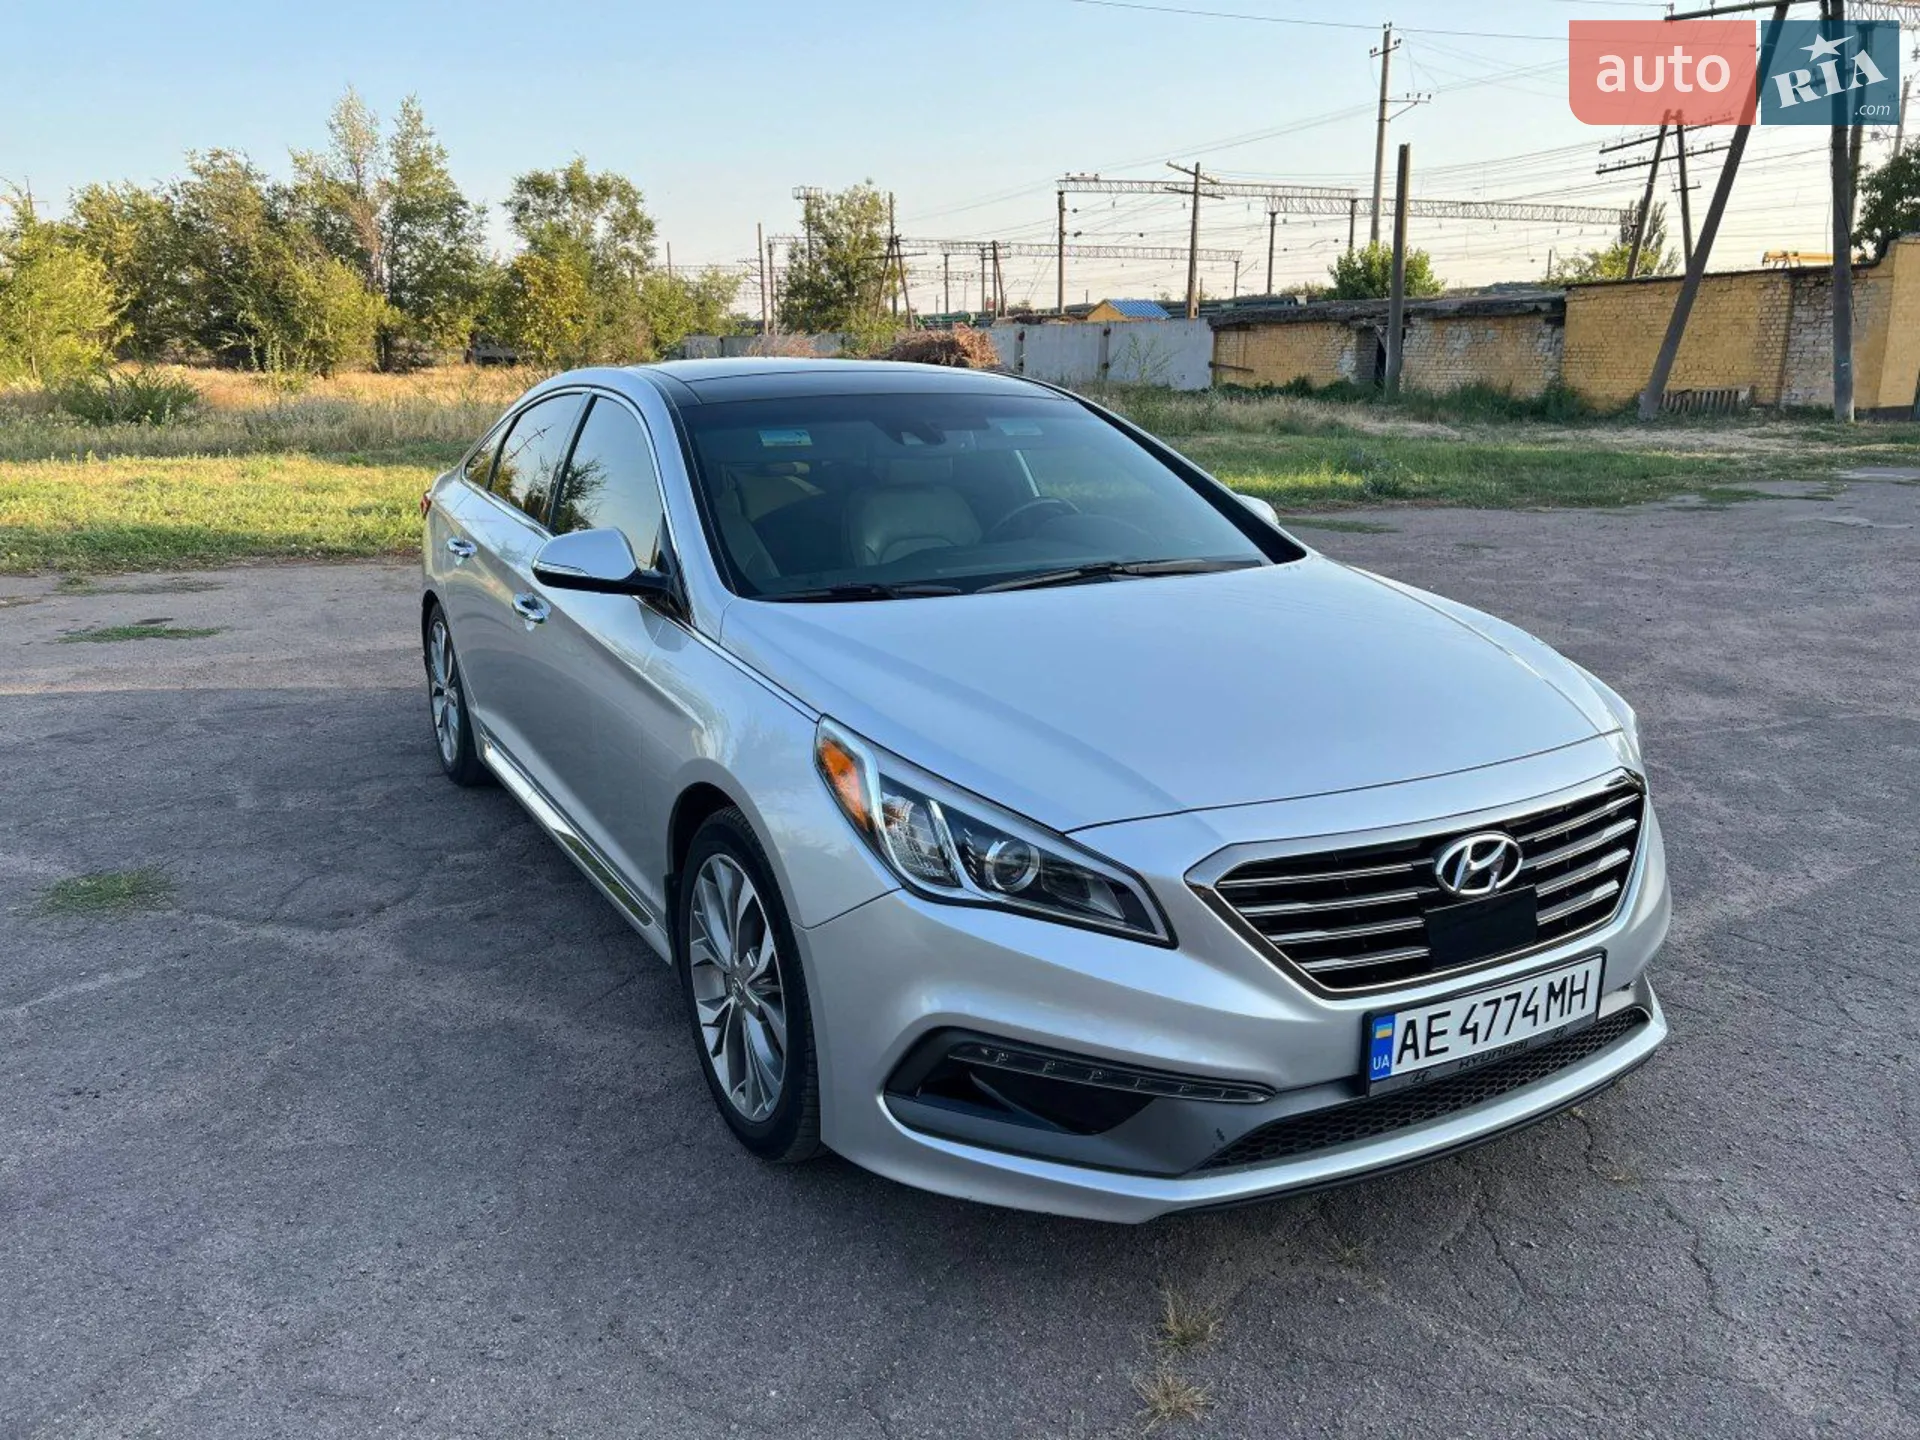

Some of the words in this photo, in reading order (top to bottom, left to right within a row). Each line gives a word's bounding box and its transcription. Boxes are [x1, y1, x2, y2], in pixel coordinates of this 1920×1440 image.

[1396, 1010, 1451, 1065] AE
[1459, 986, 1539, 1045] 4774
[1545, 970, 1589, 1023] MH
[1373, 1054, 1390, 1071] UA
